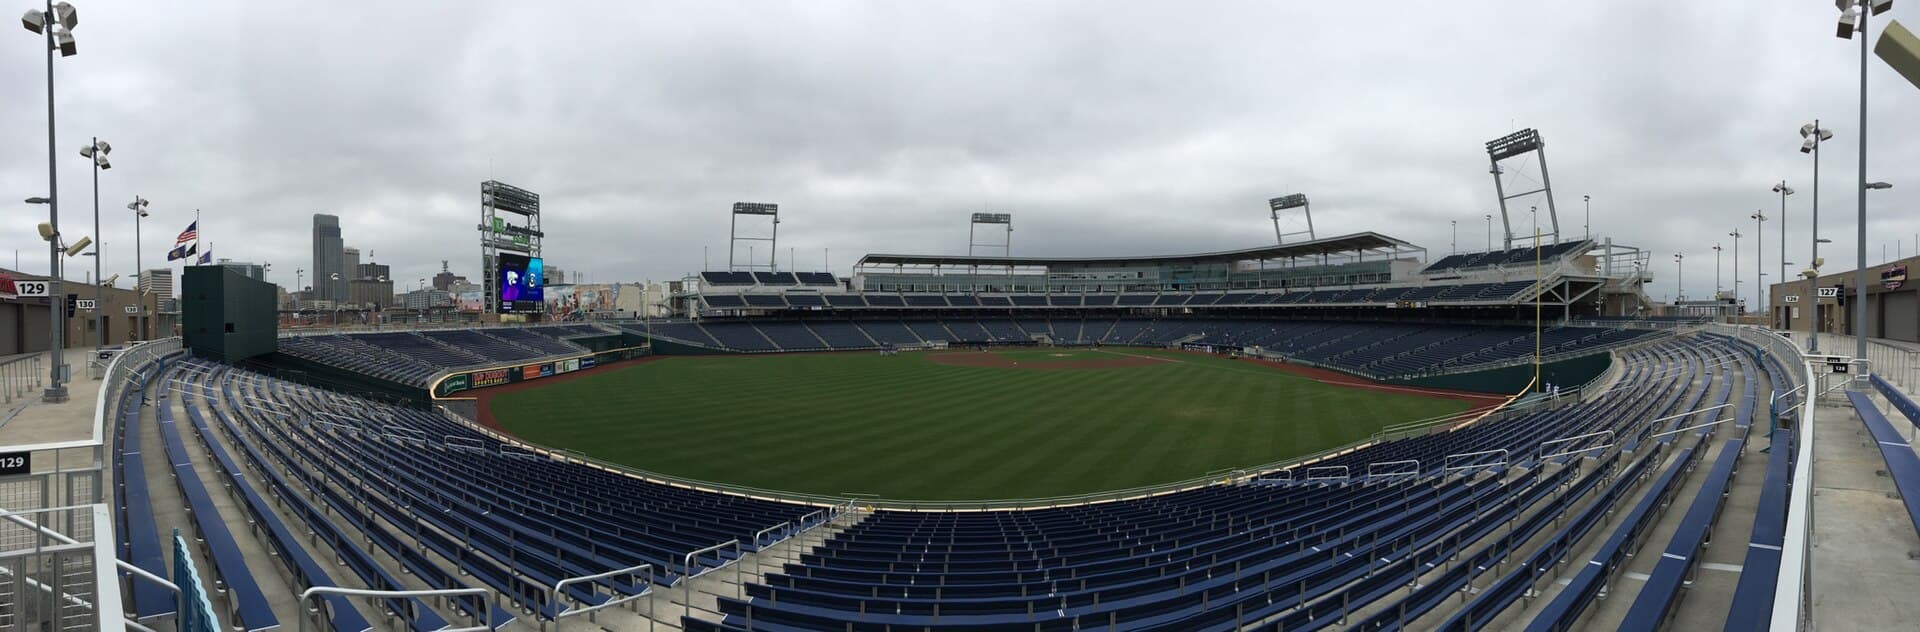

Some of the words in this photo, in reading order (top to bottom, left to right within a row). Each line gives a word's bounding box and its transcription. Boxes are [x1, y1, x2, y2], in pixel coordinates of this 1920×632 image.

[19, 283, 45, 294] 129
[1820, 288, 1836, 296] 127
[0, 456, 24, 468] 129
